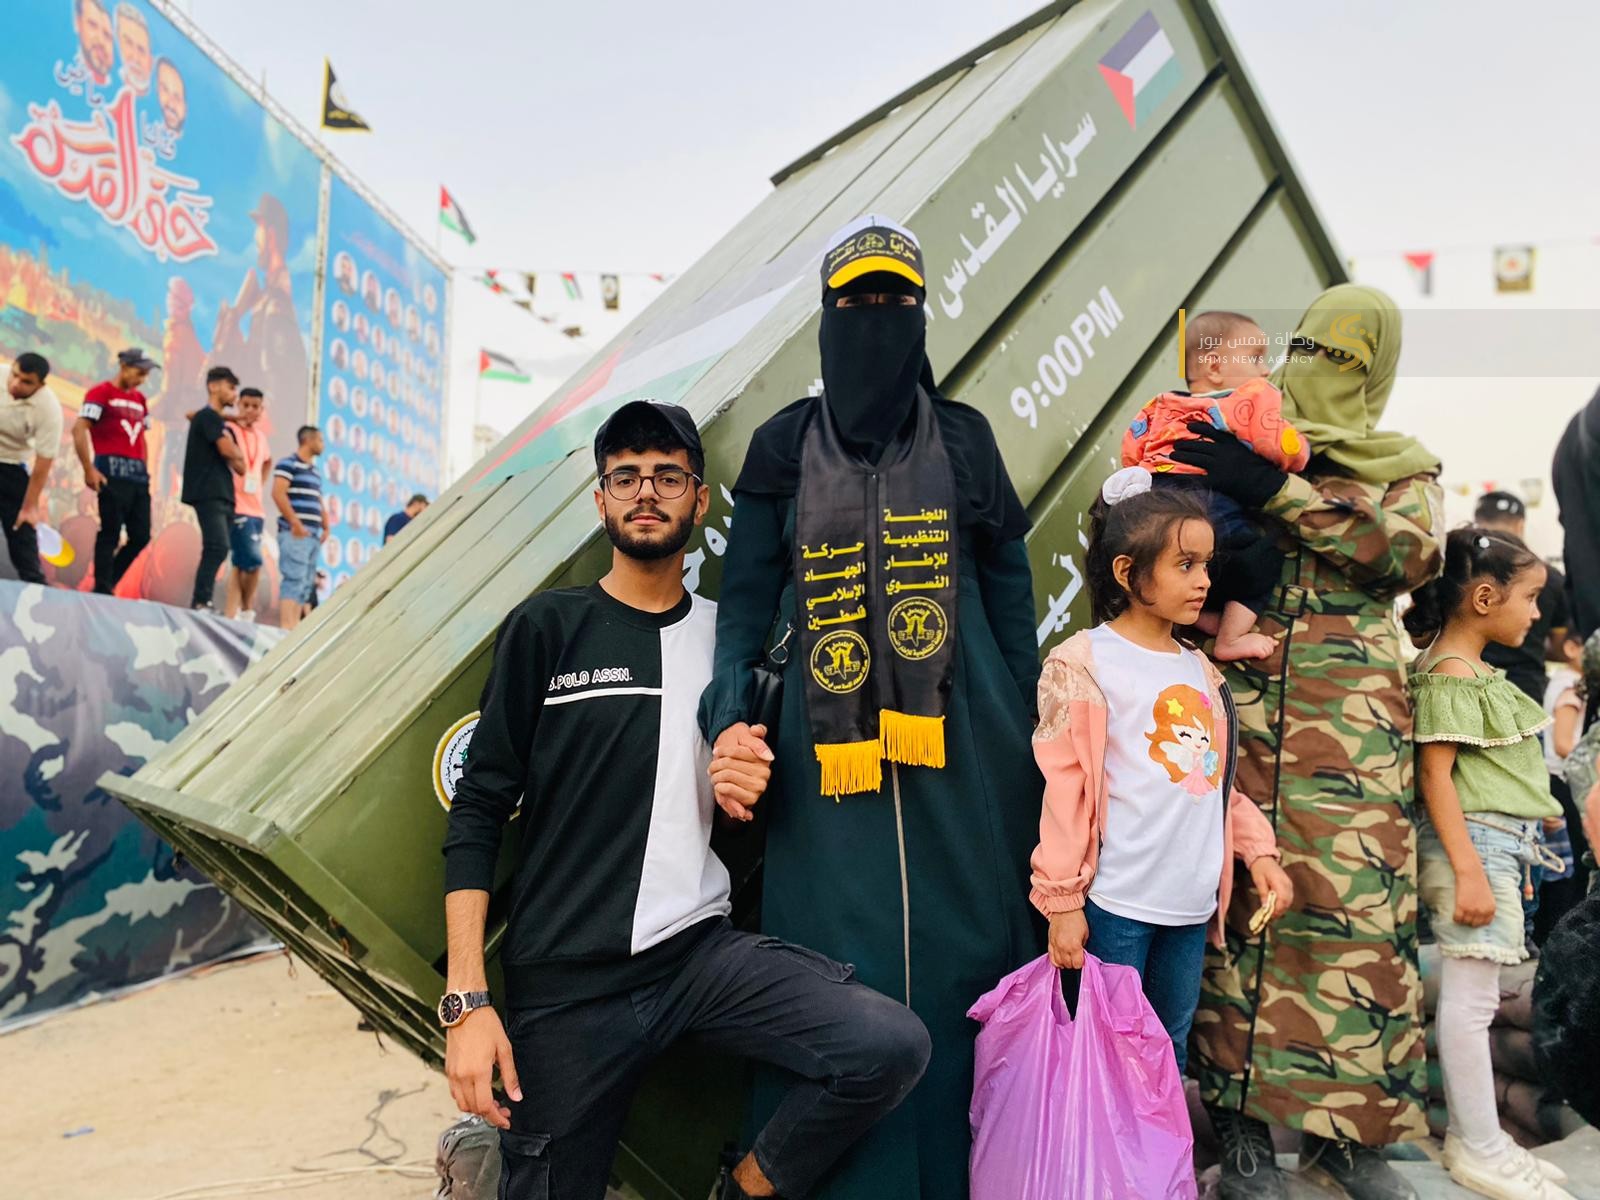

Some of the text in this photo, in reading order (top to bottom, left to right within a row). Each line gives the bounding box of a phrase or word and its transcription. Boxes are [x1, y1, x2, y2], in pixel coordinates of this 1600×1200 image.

[939, 112, 1097, 319] سرايا القدس
[1010, 285, 1125, 429] 9:00PM
[883, 508, 948, 523] اللجنة
[883, 529, 949, 547] التنظيمية
[801, 541, 865, 559] حركة
[804, 561, 866, 582] الجهاد
[885, 575, 949, 595] النسوي
[807, 604, 867, 630] فلسطين
[592, 667, 633, 683] ASSN.
